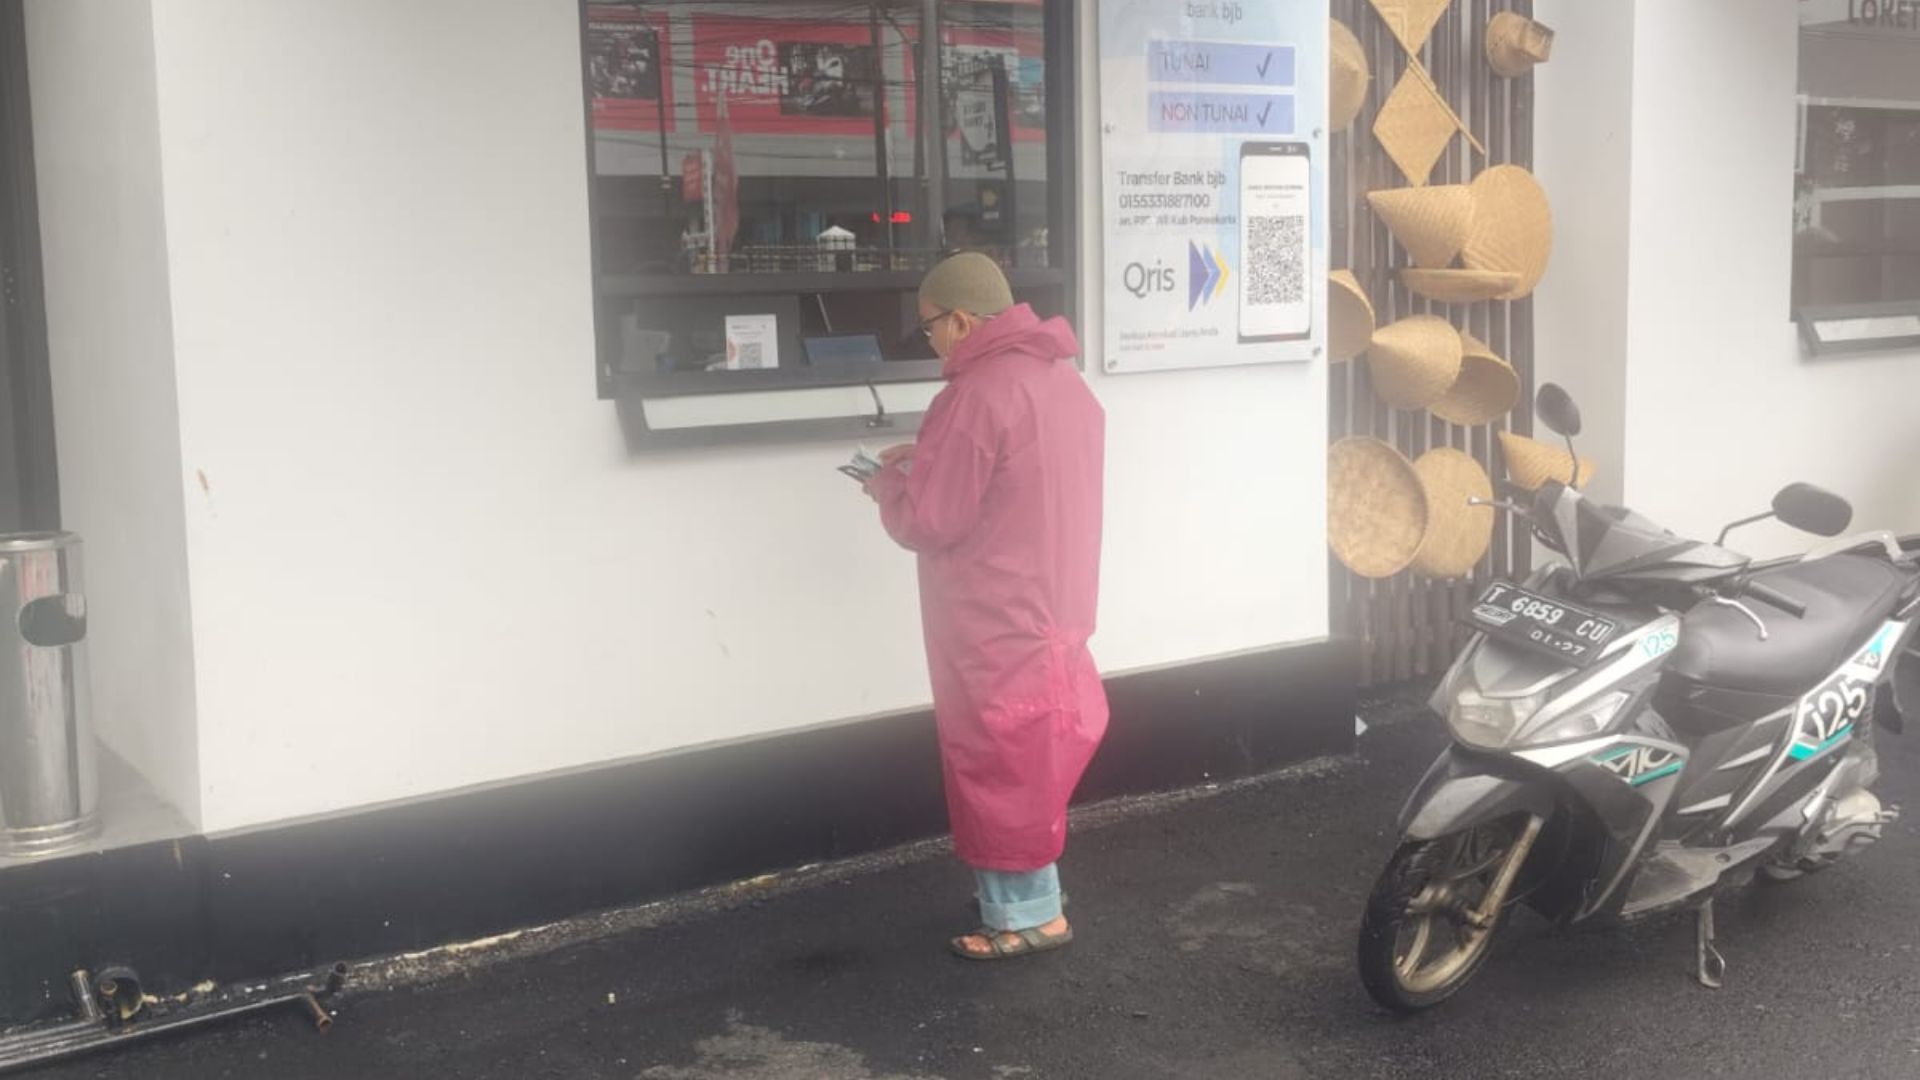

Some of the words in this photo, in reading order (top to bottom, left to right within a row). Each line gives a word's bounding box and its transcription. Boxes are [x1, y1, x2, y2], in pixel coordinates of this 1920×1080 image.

[1160, 52, 1209, 71] TUNAI
[1161, 104, 1199, 121] NON
[1202, 104, 1248, 122] TUNAI
[1119, 171, 1170, 186] Transfer
[1173, 171, 1204, 186] Bank
[1207, 171, 1226, 189] bjb
[1123, 259, 1176, 299] Qris
[1487, 587, 1506, 602] T
[1511, 597, 1565, 624] 6859
[1576, 620, 1609, 640] CU
